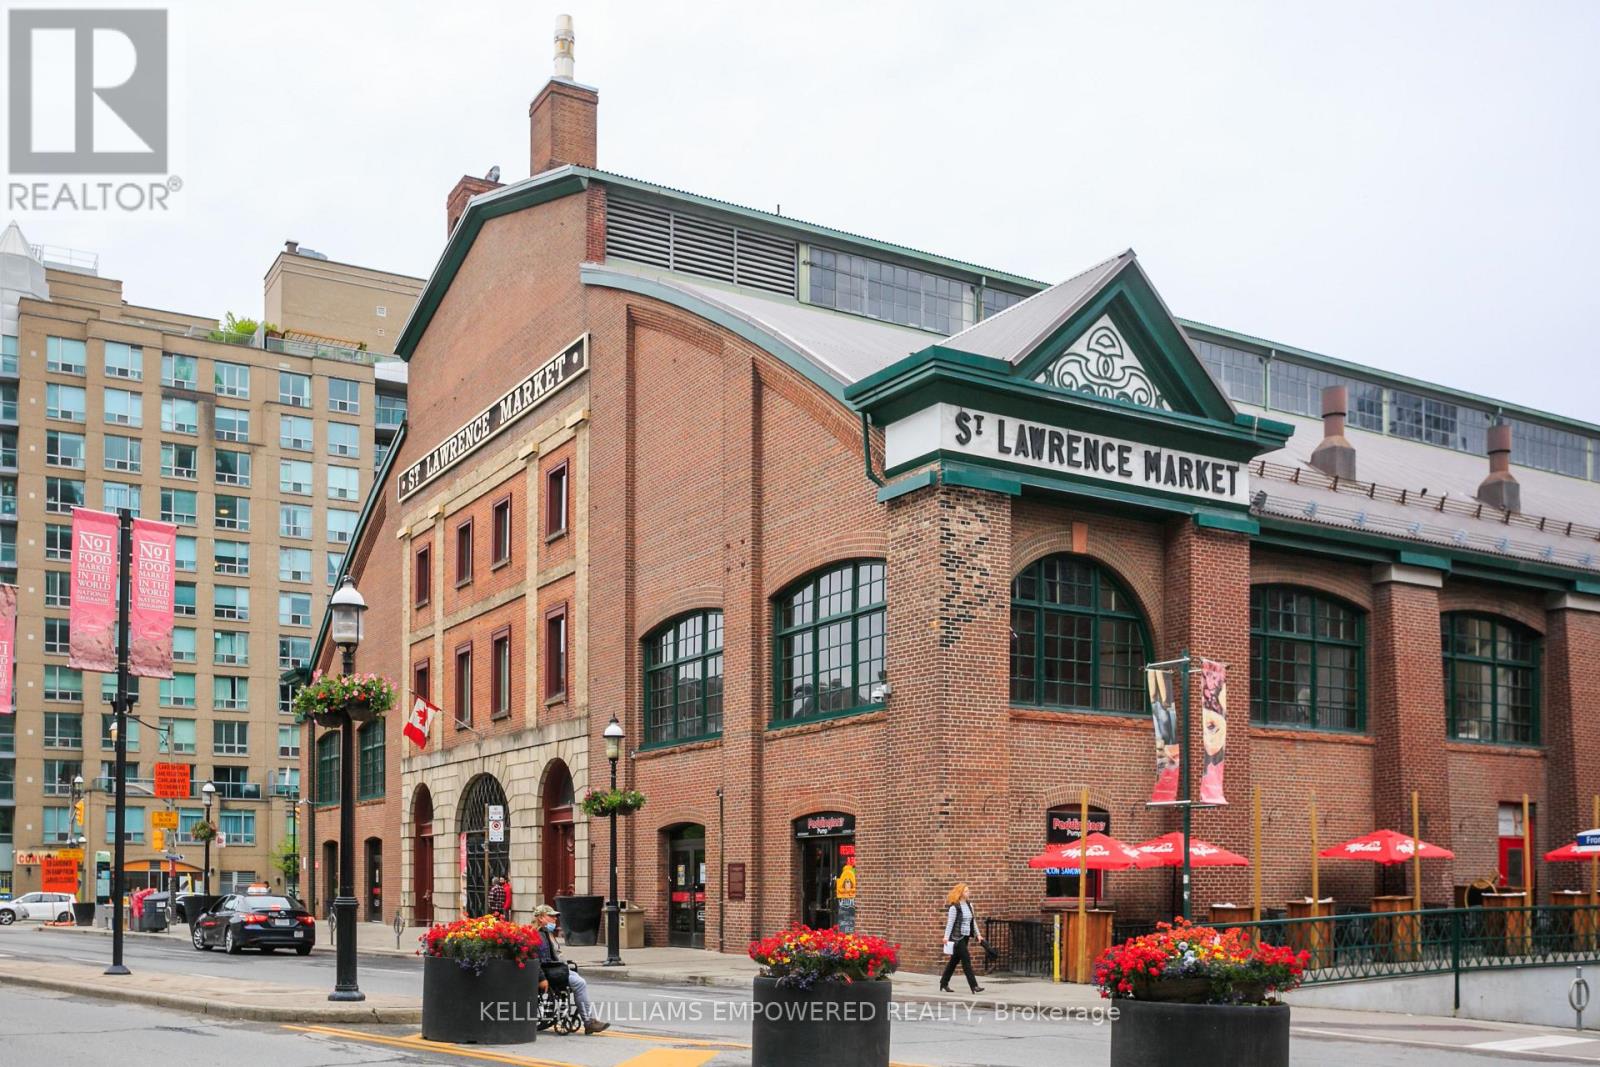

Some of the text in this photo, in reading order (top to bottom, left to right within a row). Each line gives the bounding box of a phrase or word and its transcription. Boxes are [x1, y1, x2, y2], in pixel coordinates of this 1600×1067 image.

[408, 354, 566, 490] ST LAWRENCE MARKET
[998, 419, 1133, 477] LAWRENCE
[1144, 449, 1240, 496] MARKET
[79, 552, 112, 565] FOOD
[79, 562, 111, 573] MARKET
[139, 561, 171, 574] FOOD
[78, 570, 111, 582] IN THE
[139, 570, 169, 580] MARKET
[79, 580, 111, 591] WORLD
[139, 579, 169, 591] IN THE
[139, 587, 170, 598] WORLD
